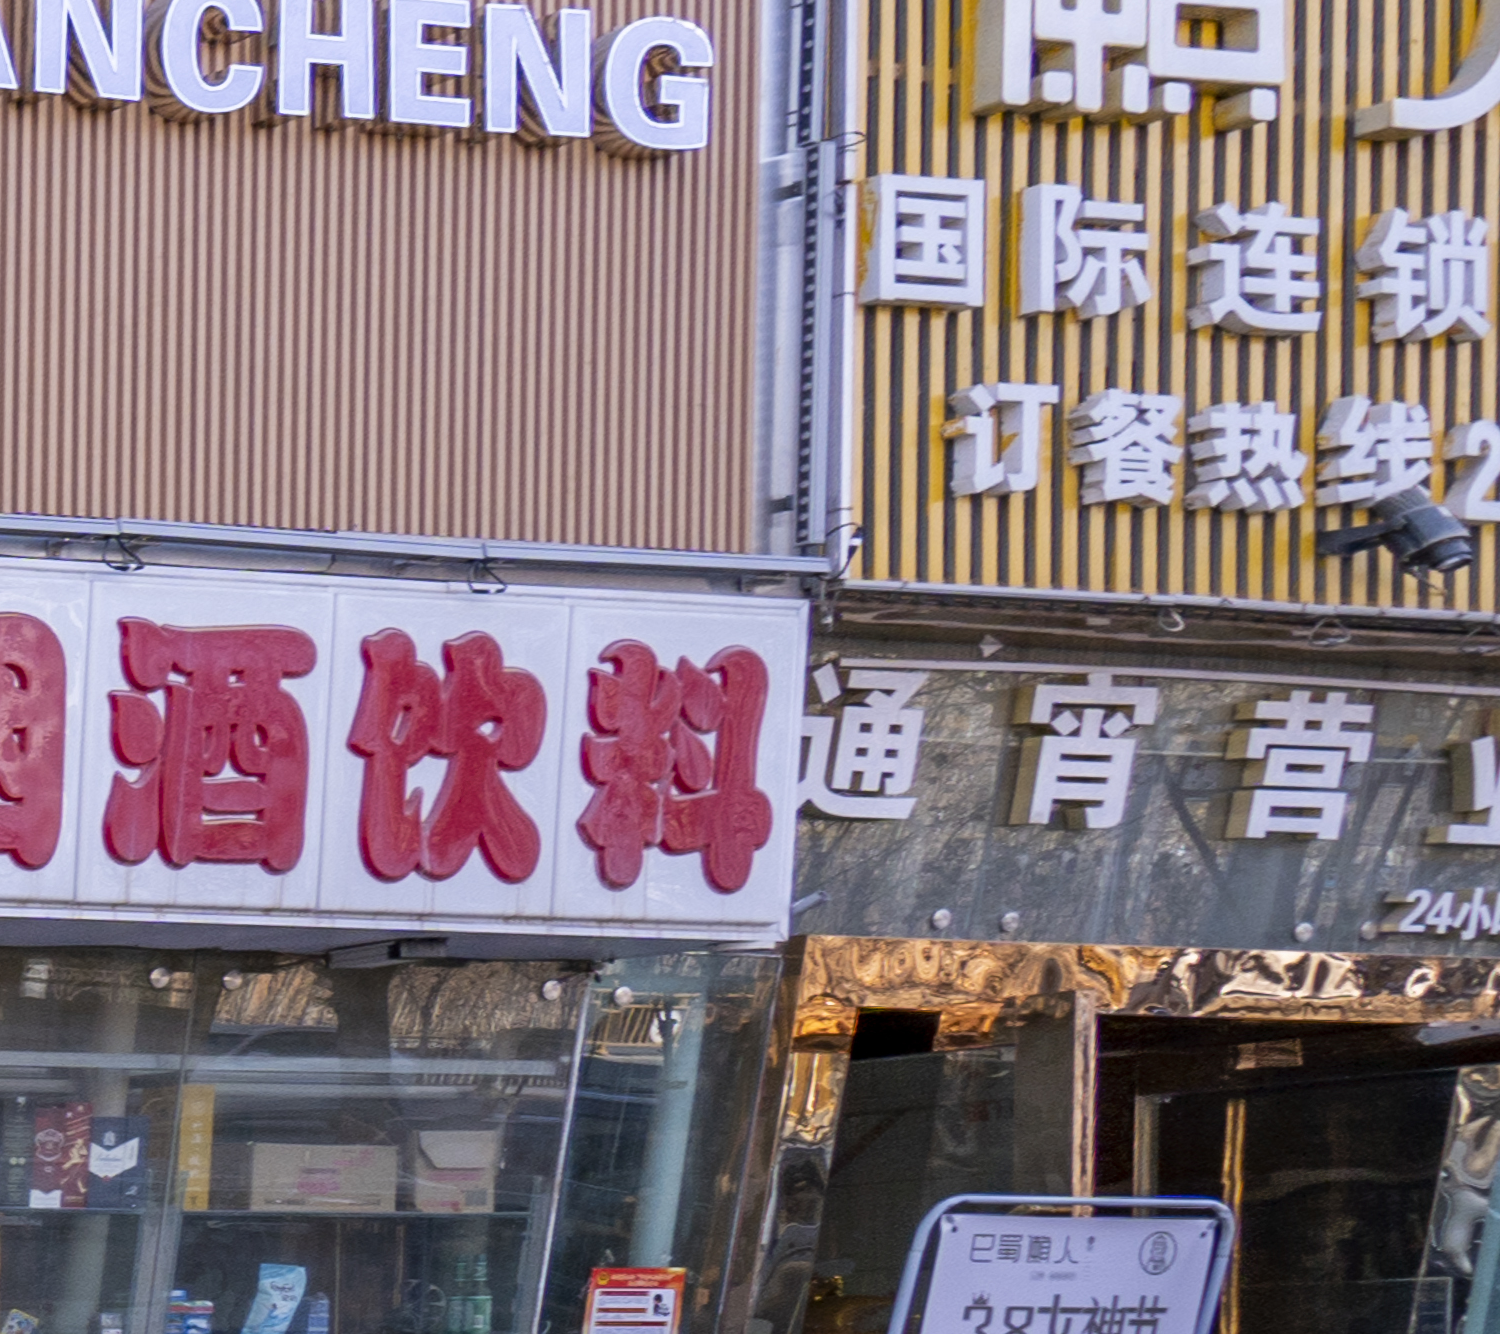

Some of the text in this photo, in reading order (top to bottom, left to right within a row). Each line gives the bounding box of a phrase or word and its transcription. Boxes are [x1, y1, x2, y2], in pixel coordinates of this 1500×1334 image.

[864, 173, 1490, 343] 国际连锁
[1398, 886, 1500, 940] 24小
